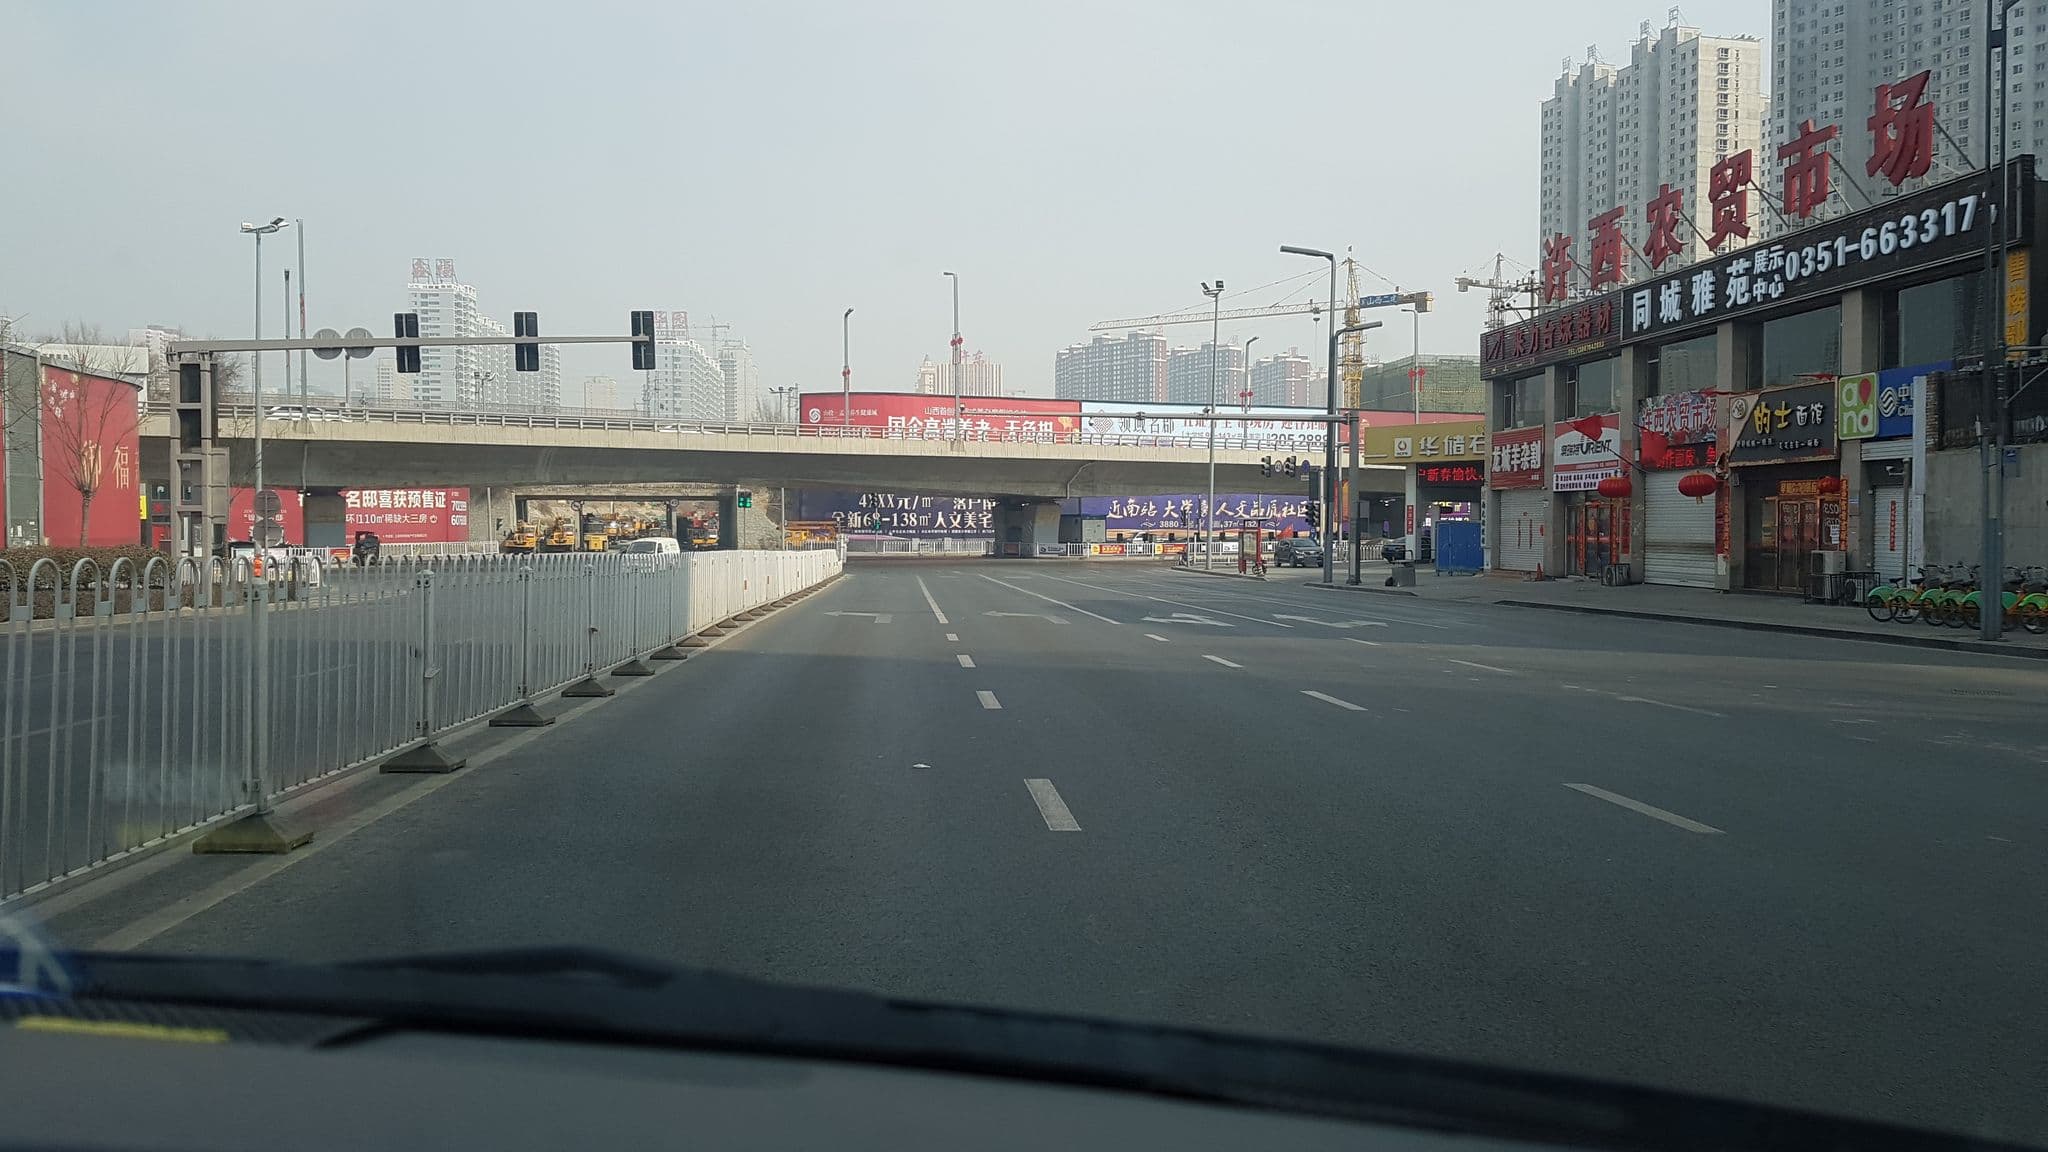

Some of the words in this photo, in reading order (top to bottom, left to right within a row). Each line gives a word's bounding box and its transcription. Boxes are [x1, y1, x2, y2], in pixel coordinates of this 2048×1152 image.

[1543, 70, 1934, 304] 许西农贸市场
[1753, 244, 1785, 275] 展示
[1631, 257, 1752, 333] 同城雅苑
[1752, 273, 1785, 303] 中心
[1898, 383, 1915, 401] 中
[1753, 400, 1825, 434] 的士面馆
[1491, 440, 1541, 473] 龙城羊杂割
[345, 490, 447, 509] 名邸喜获预售证
[1106, 498, 1158, 519] 近南站
